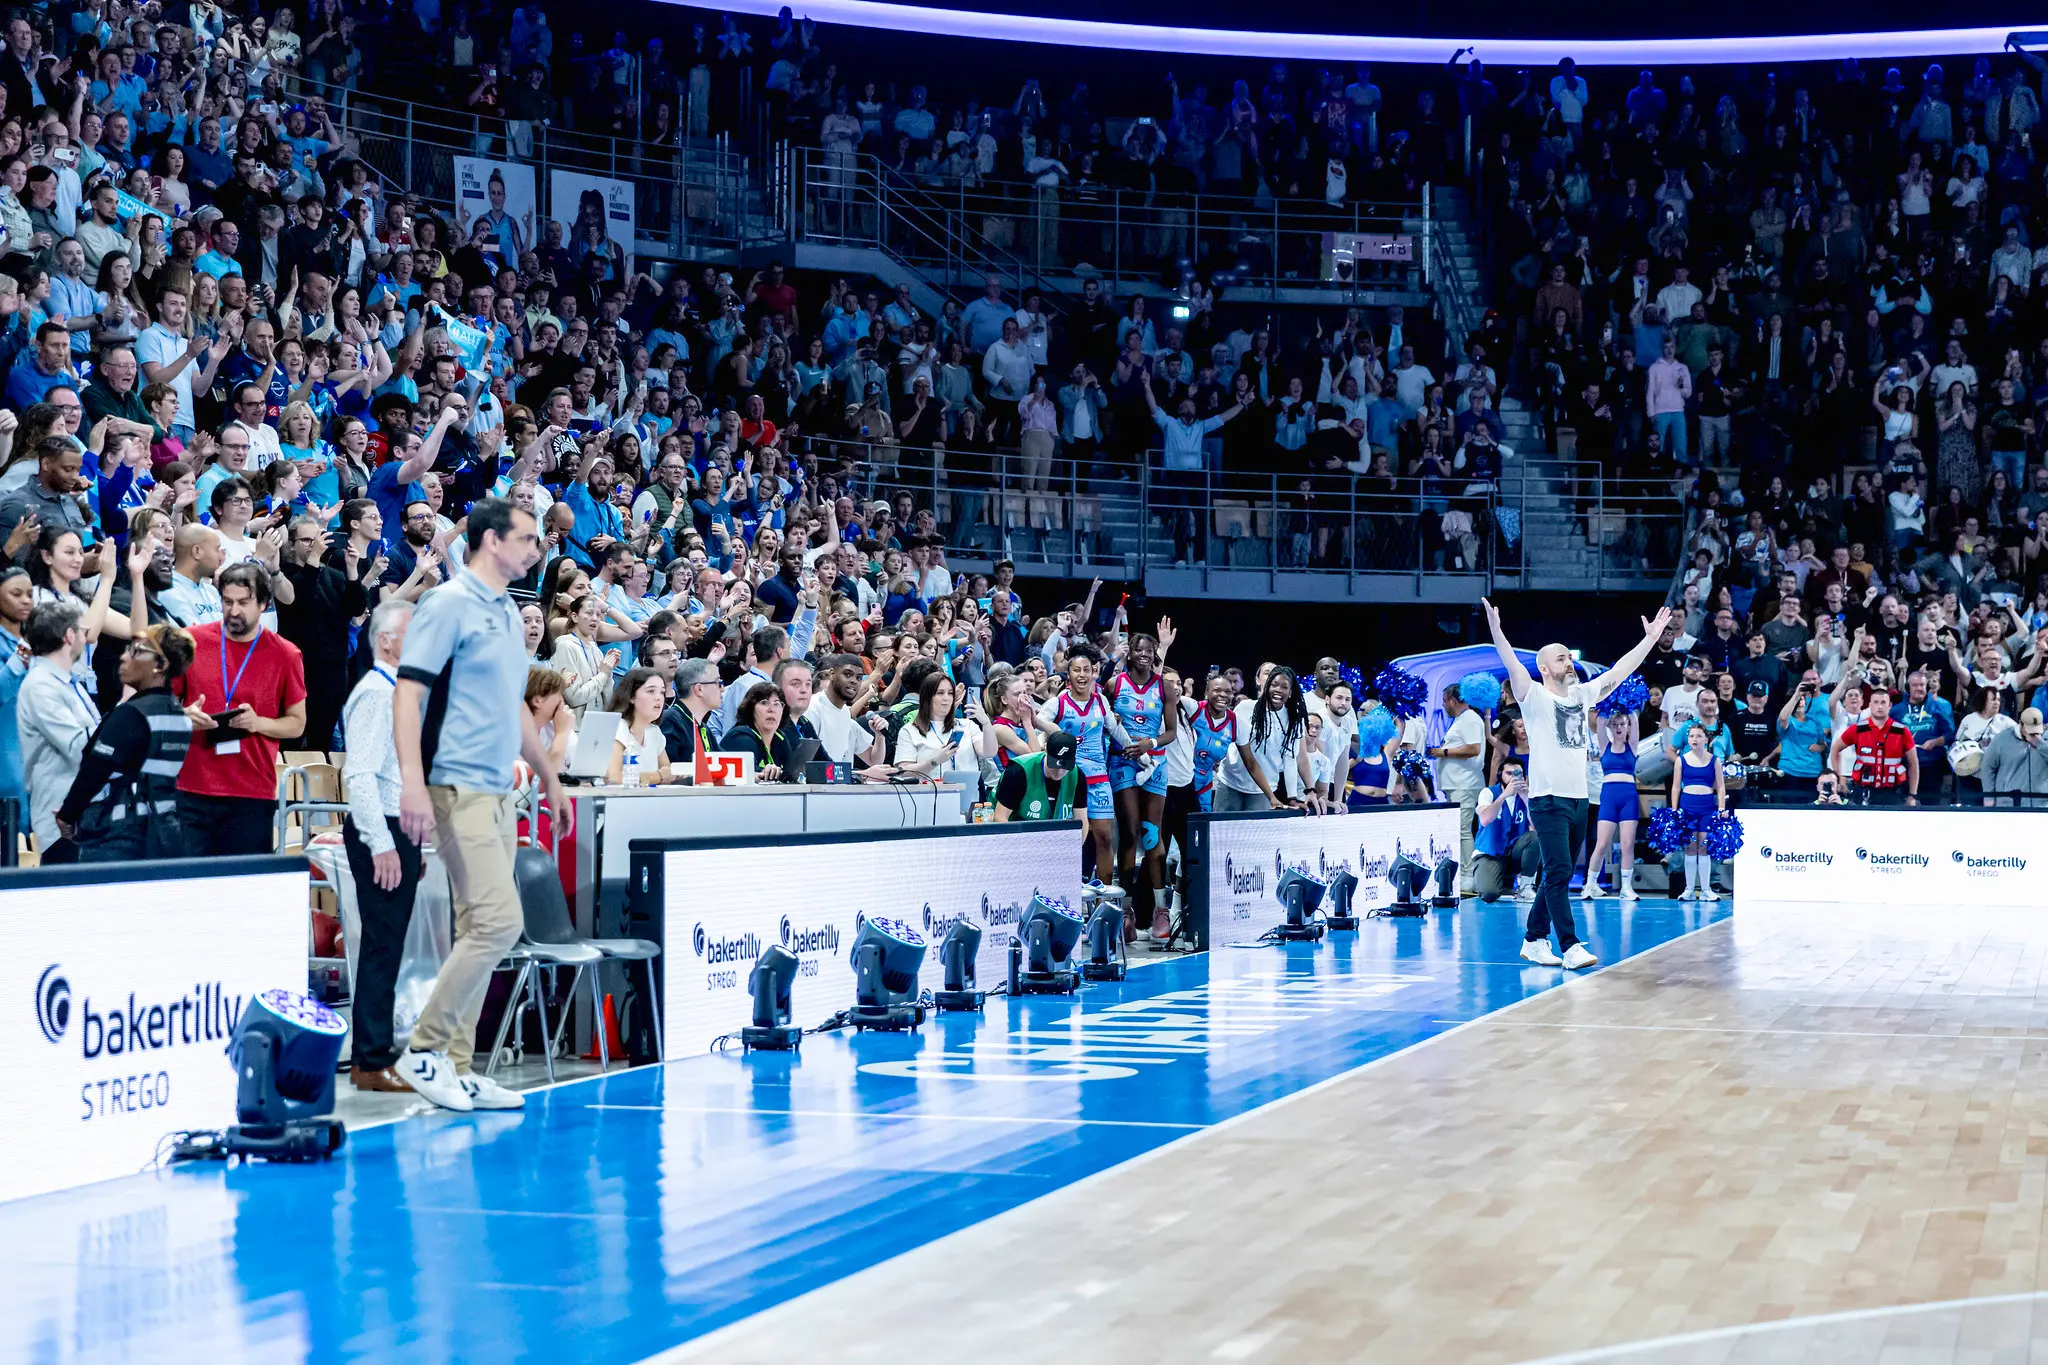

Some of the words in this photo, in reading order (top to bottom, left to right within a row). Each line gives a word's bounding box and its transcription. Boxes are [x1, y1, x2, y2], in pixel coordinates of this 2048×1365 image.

[1135, 700, 1145, 711] 24
[1776, 852, 1833, 866] bakertilly
[1871, 853, 1929, 868] bakertilly
[1967, 856, 2027, 870] bakertilly
[1233, 865, 1265, 899] bakertilly
[707, 932, 761, 967] bakertilly
[793, 924, 840, 956] bakertilly
[707, 970, 737, 991] STREGO
[82, 982, 242, 1060] bakertilly
[81, 1070, 171, 1121] STREGO
